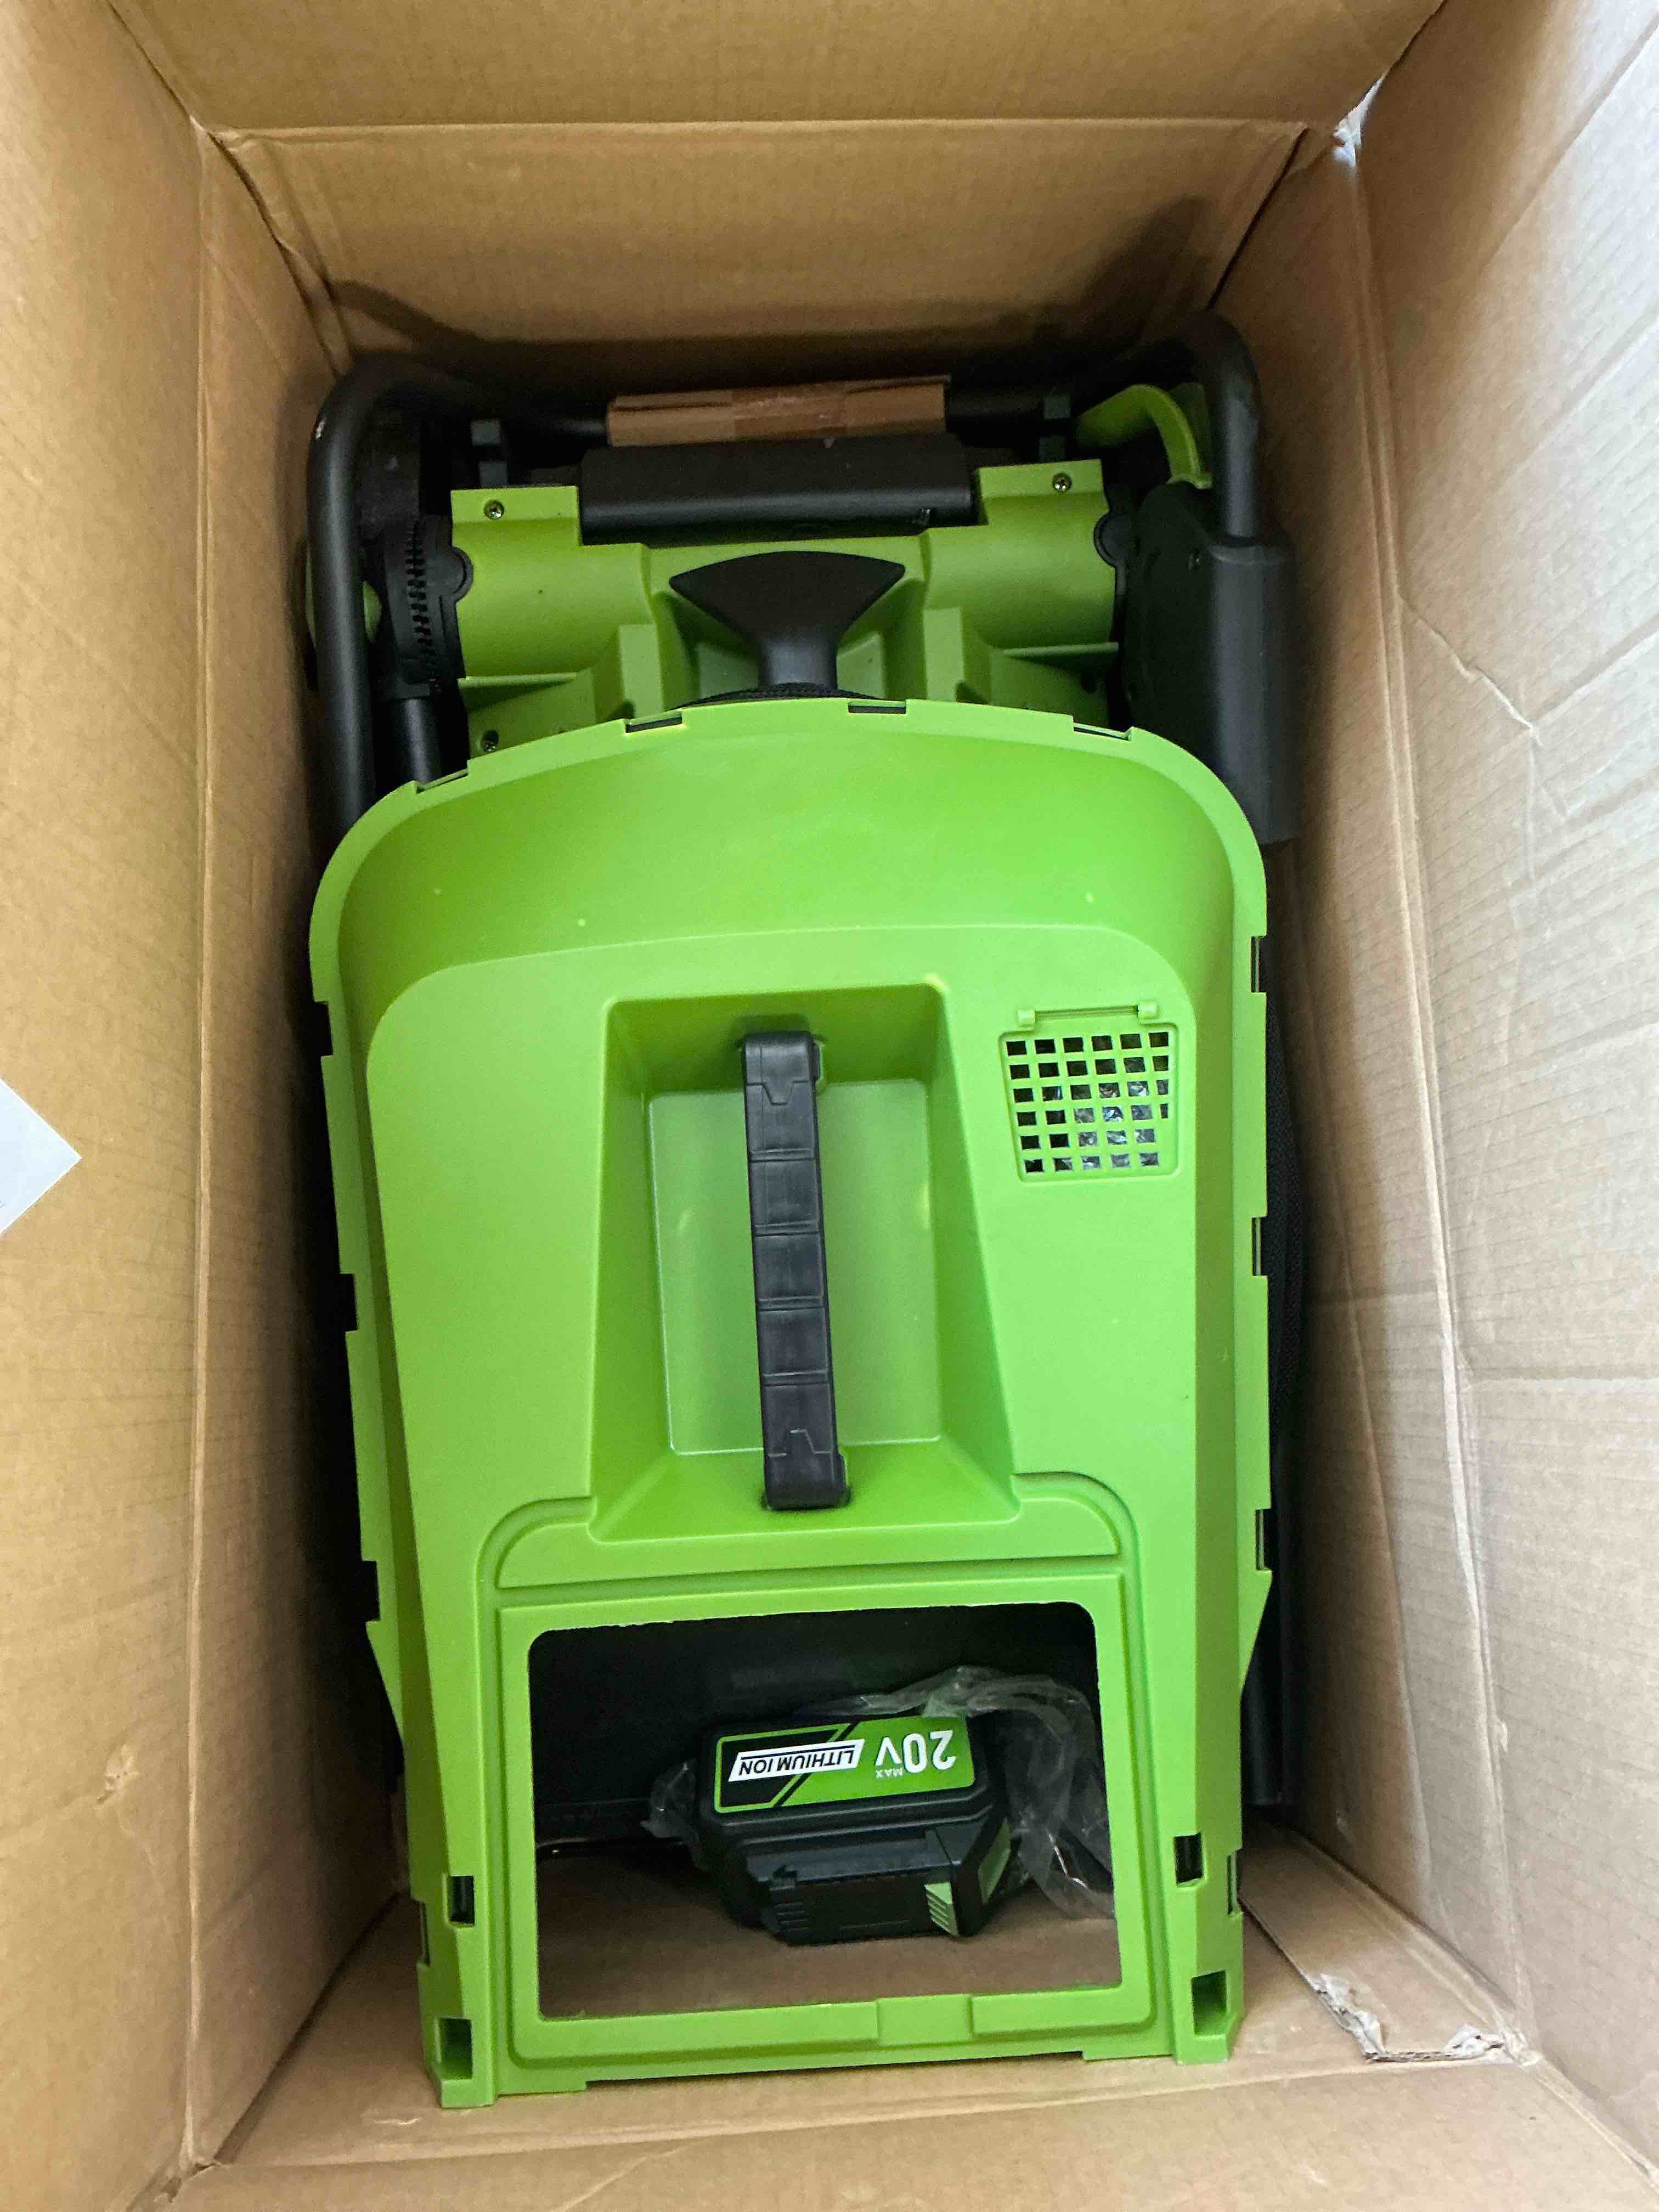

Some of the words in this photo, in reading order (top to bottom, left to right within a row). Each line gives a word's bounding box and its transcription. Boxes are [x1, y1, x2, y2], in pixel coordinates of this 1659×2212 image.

[777, 1750, 854, 1772] LITHIUM
[875, 1730, 956, 1774] 20V
[738, 1758, 773, 1776] ION
[876, 1768, 903, 1778] MAX
